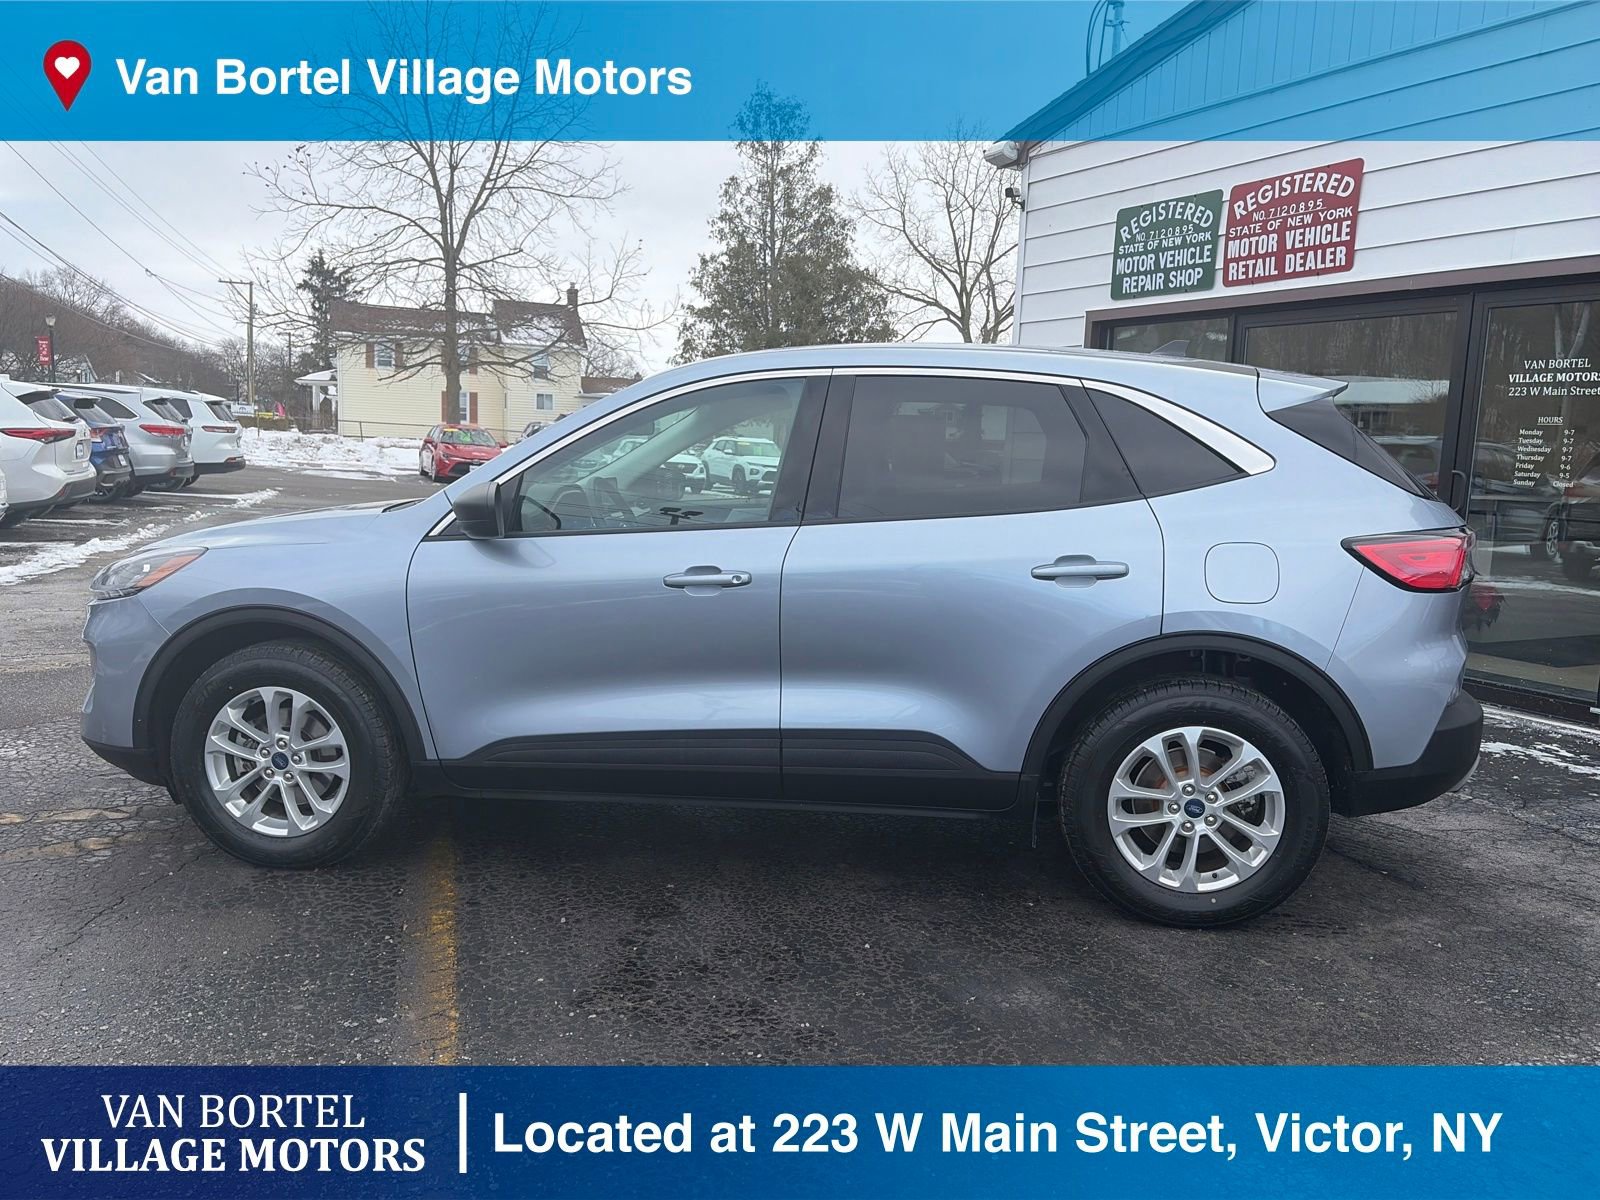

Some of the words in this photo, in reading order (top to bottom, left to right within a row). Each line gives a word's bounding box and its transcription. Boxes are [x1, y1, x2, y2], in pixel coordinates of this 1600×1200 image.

[1233, 172, 1355, 220] REGISTERED
[1269, 198, 1324, 219] 7120895
[1120, 201, 1214, 243] REGISTERED
[1229, 222, 1262, 238] STATE
[1267, 219, 1283, 231] OF
[1287, 213, 1313, 228] NEW
[1318, 206, 1353, 222] YORK
[1149, 223, 1195, 240] 7120895
[1119, 242, 1144, 255] STATE
[1147, 239, 1160, 251] OF
[1161, 236, 1183, 248] NEW
[1185, 231, 1212, 244] YORK
[1227, 233, 1278, 259] MOTOR
[1285, 220, 1352, 250] VEHICLE
[1116, 253, 1155, 275] MOTOR
[1159, 244, 1213, 269] VEHICLE
[1228, 256, 1279, 281] RETAIL
[1284, 246, 1347, 274] DEALER
[1122, 272, 1165, 294] REPAIR
[1168, 267, 1204, 289] SHOP
[1524, 360, 1546, 370] VAN
[1548, 358, 1591, 369] BORTEL
[1508, 373, 1554, 383] VILLAGE
[1508, 387, 1527, 397] 223
[1529, 386, 1541, 396] W
[1542, 386, 1568, 396] Main
[1537, 416, 1563, 424] HOURS
[1518, 437, 1543, 445] Tuesday
[1517, 445, 1552, 454] Wednesday
[1516, 454, 1545, 462] Thursday
[1515, 462, 1535, 470] Friday
[1514, 470, 1541, 479] Saturday
[1513, 479, 1536, 487] Sunday
[1552, 480, 1574, 488] Closed
